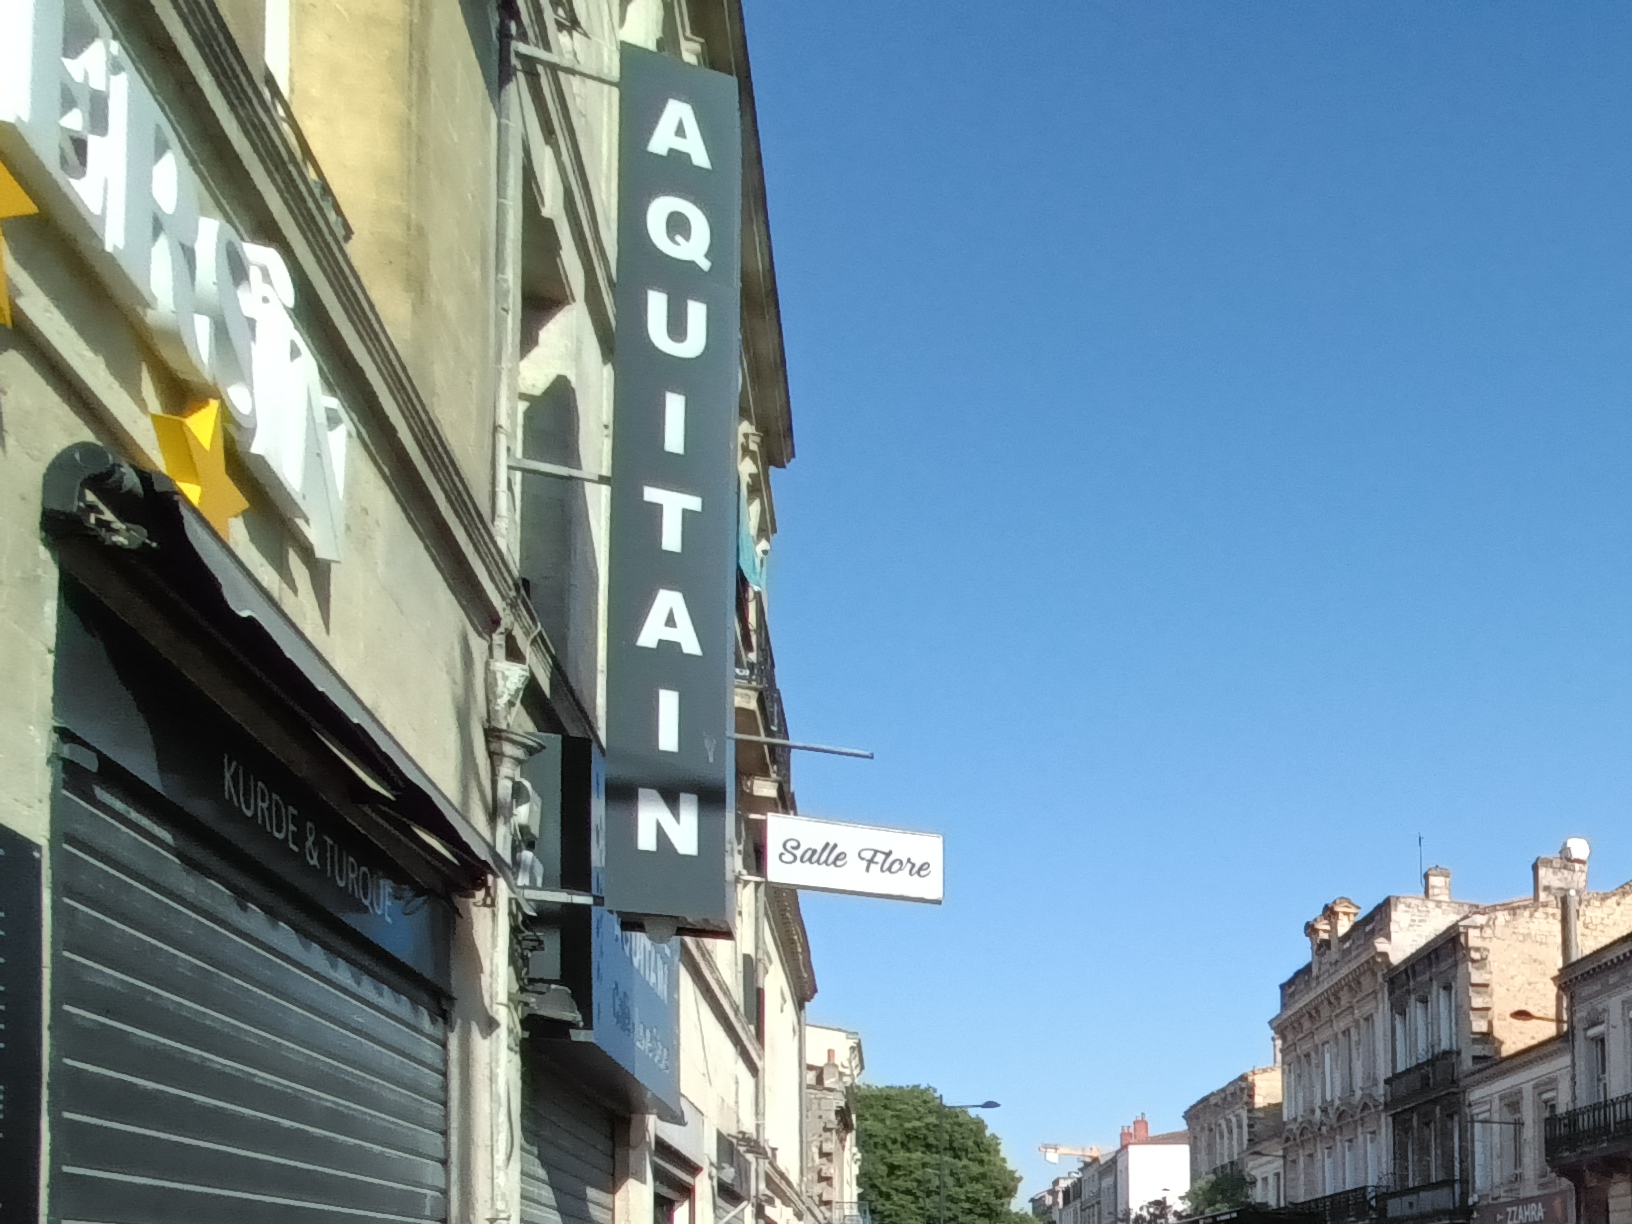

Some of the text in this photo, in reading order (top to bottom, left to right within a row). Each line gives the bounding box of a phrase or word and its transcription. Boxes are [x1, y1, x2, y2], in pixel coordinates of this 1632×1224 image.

[636, 98, 712, 857] AQUITAIN
[224, 752, 394, 925] KURDE & TURQUE
[778, 837, 932, 879] Salle Flore
